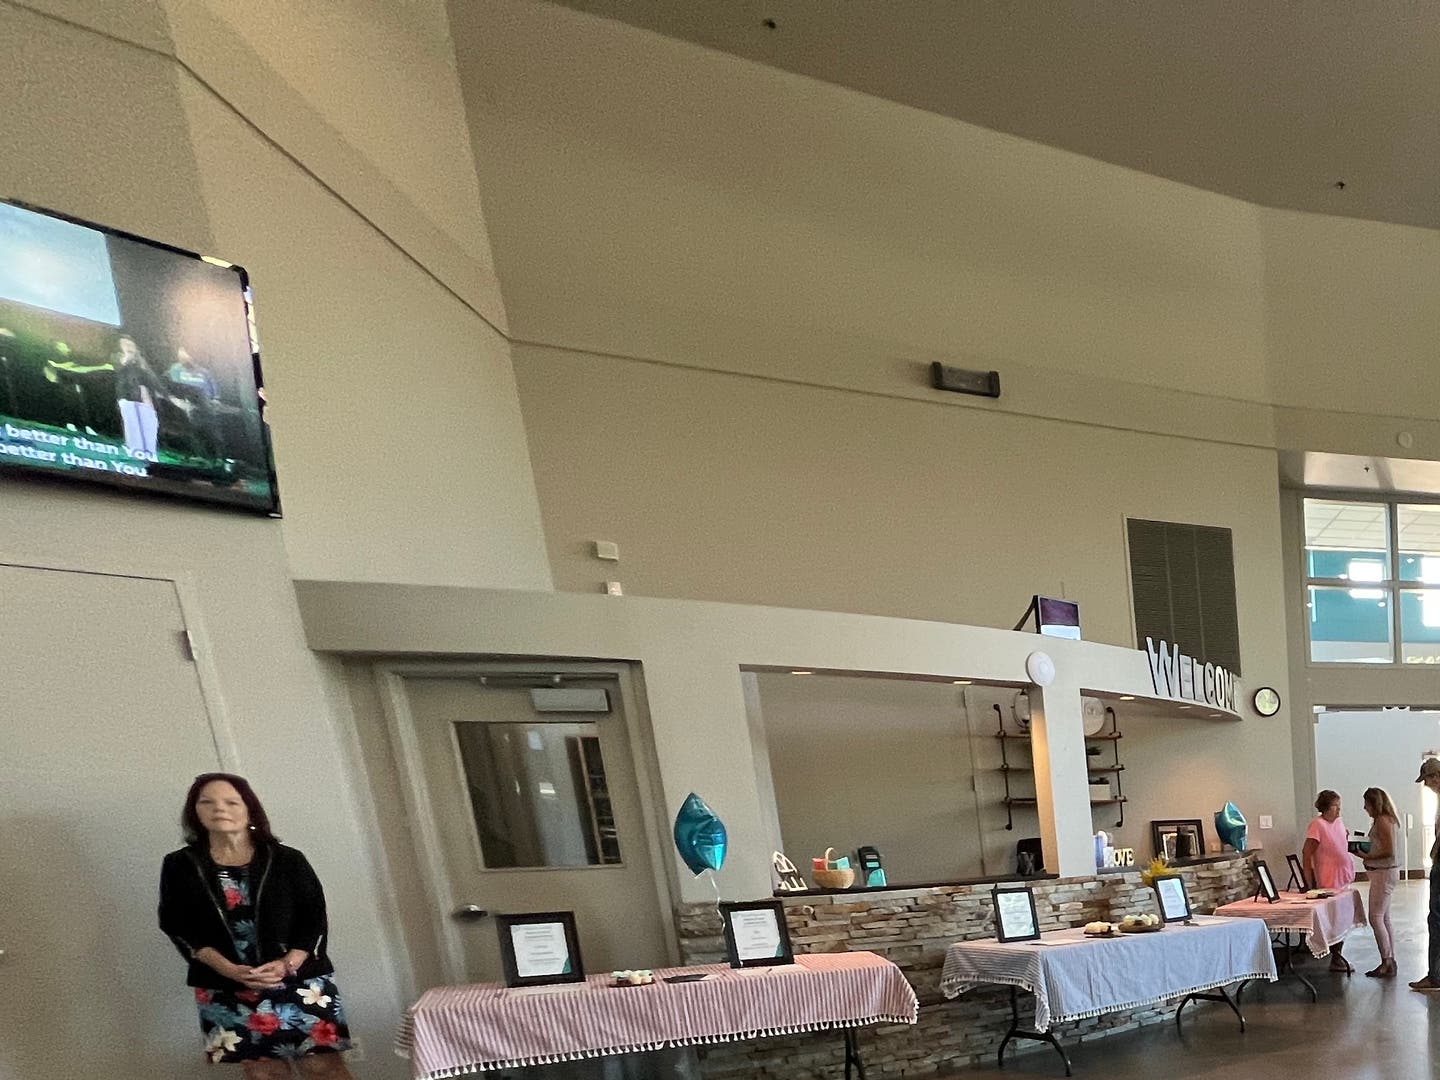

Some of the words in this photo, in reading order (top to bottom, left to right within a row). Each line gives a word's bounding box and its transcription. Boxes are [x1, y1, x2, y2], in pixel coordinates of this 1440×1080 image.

[5, 423, 70, 446] better
[72, 436, 119, 455] than
[121, 444, 159, 463] You
[61, 452, 108, 471] than
[111, 460, 149, 477] You
